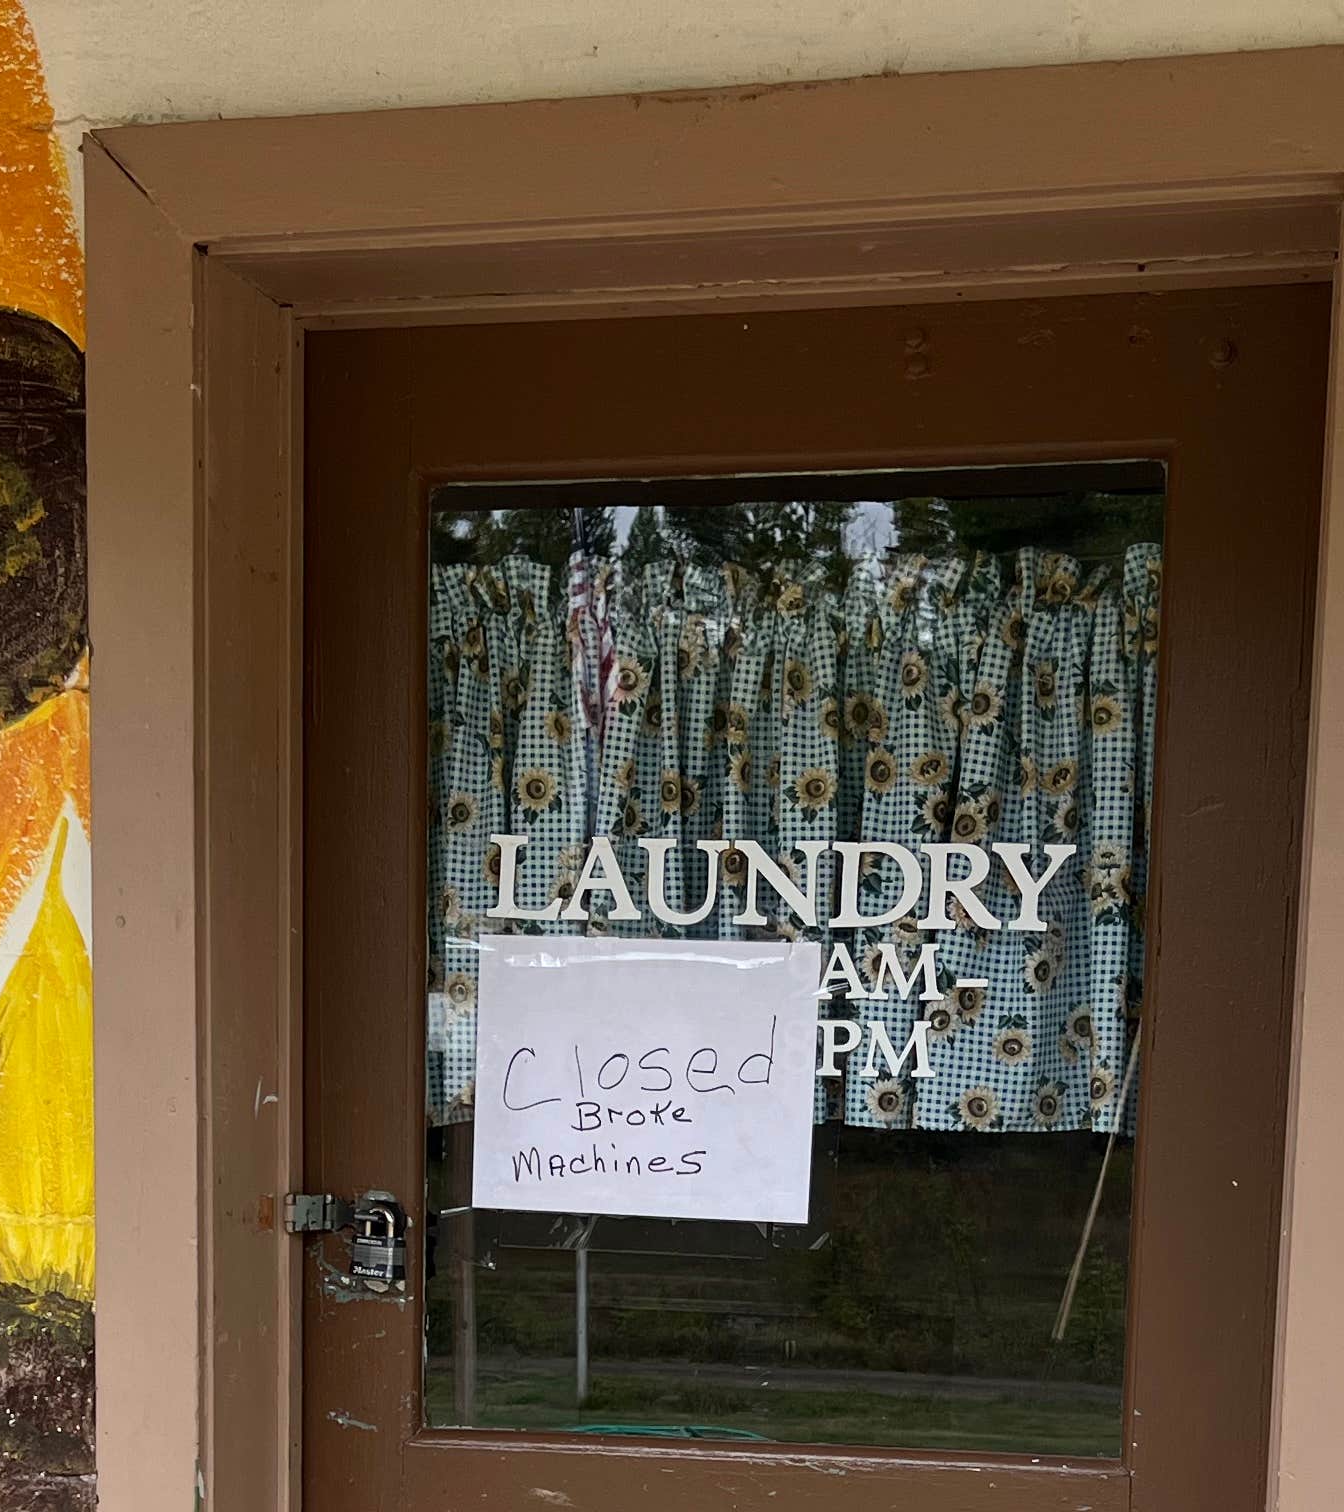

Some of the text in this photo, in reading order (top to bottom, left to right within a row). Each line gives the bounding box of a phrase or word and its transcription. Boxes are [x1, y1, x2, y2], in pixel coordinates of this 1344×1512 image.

[487, 834, 1076, 932] LAUNDRY
[503, 1014, 777, 1111] Closed
[815, 1020, 936, 1077] PM
[352, 1265, 384, 1277] Master
